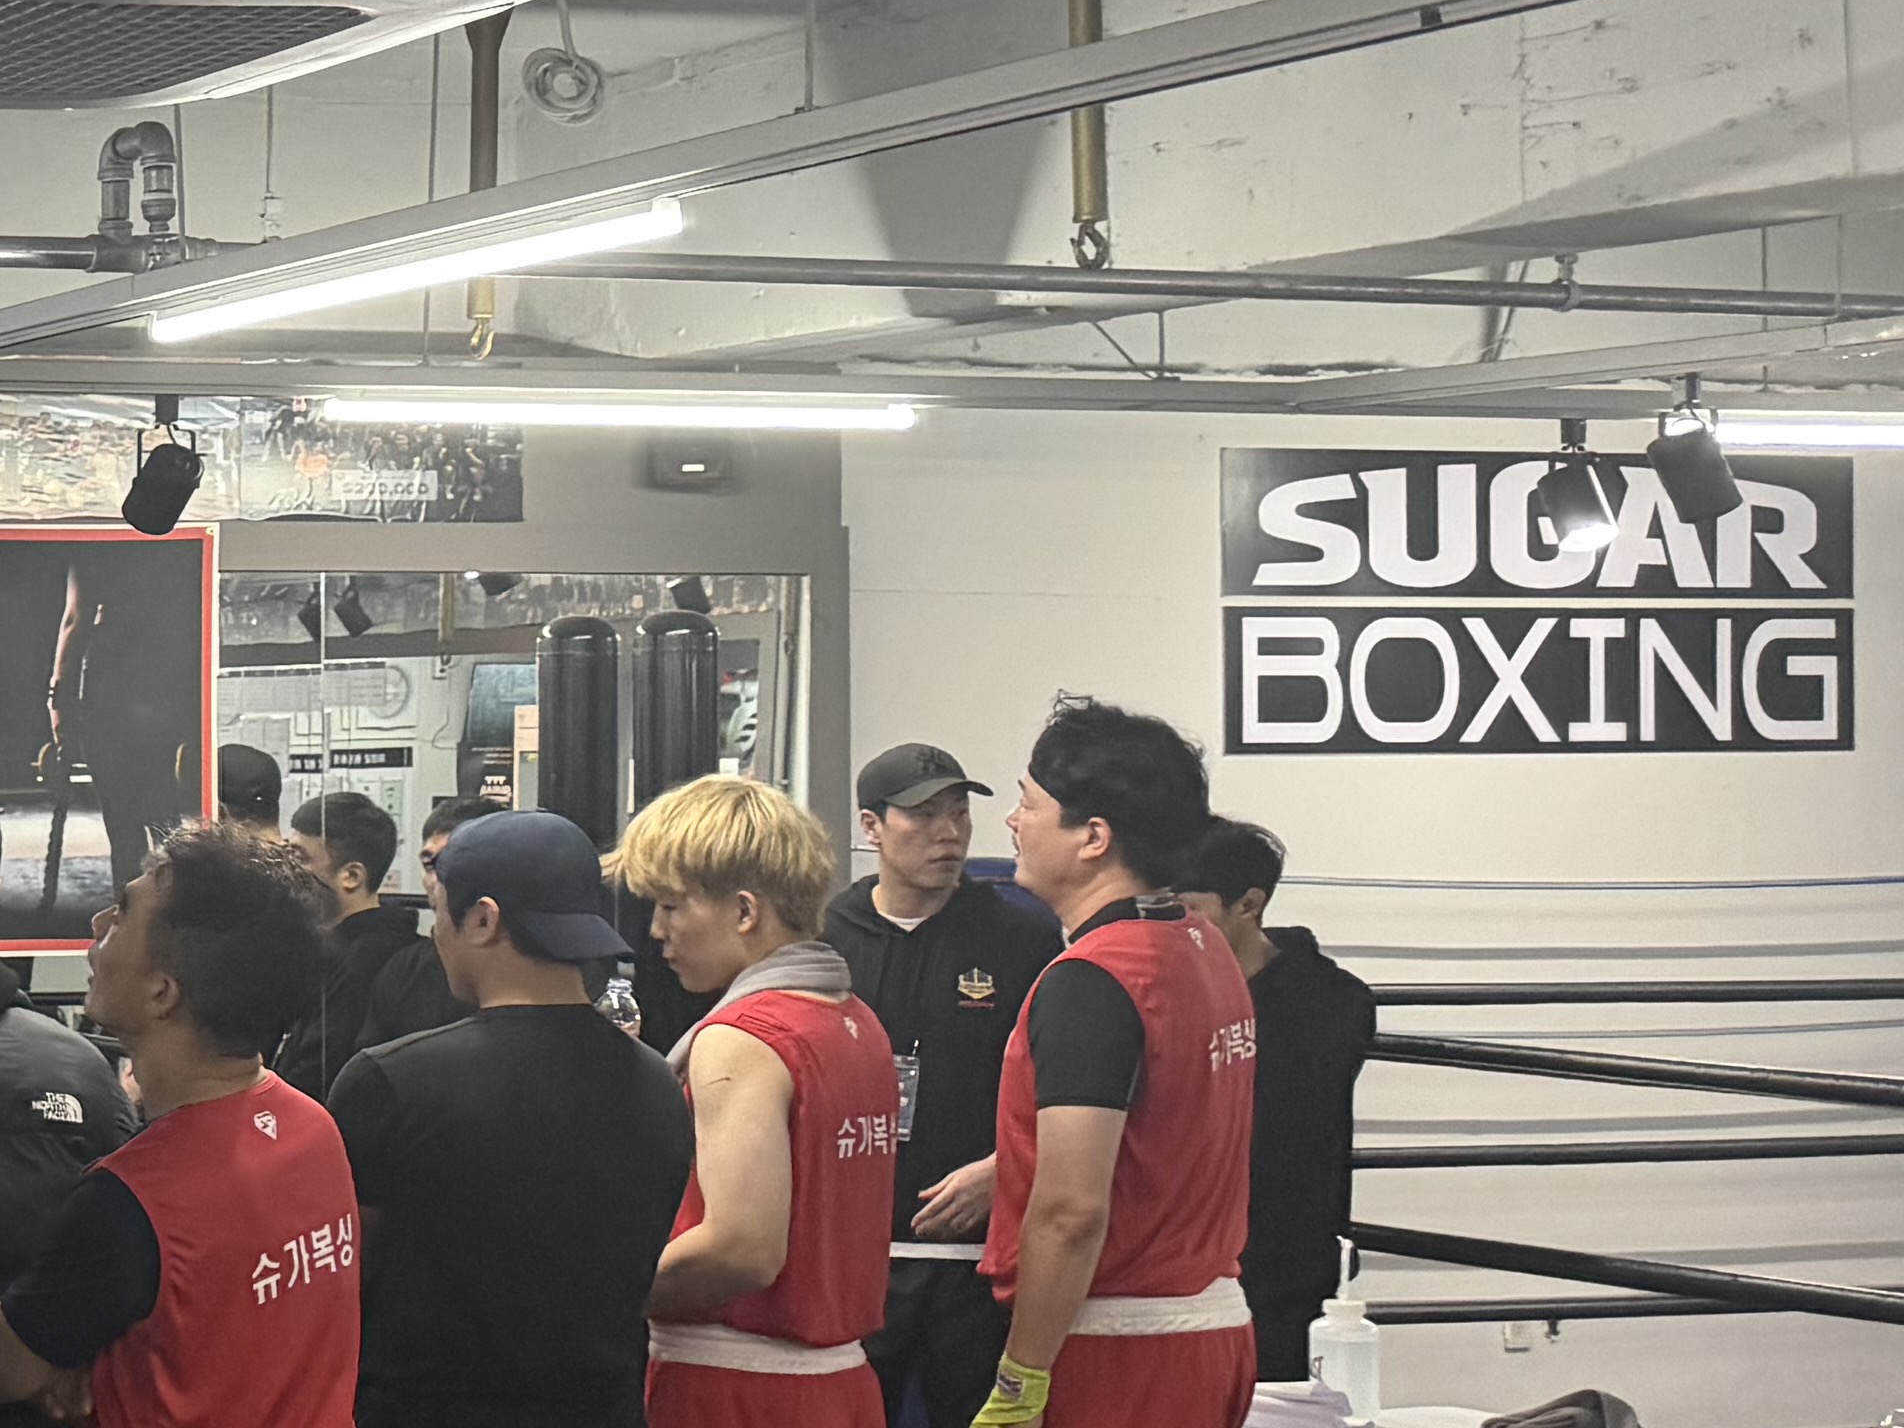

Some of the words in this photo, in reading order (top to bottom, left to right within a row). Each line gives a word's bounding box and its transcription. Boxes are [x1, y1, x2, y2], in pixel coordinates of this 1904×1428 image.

[1252, 460, 1828, 590] SUGAR
[1241, 617, 1839, 744] BOXING
[252, 1213, 354, 1305] 슈가복싱
